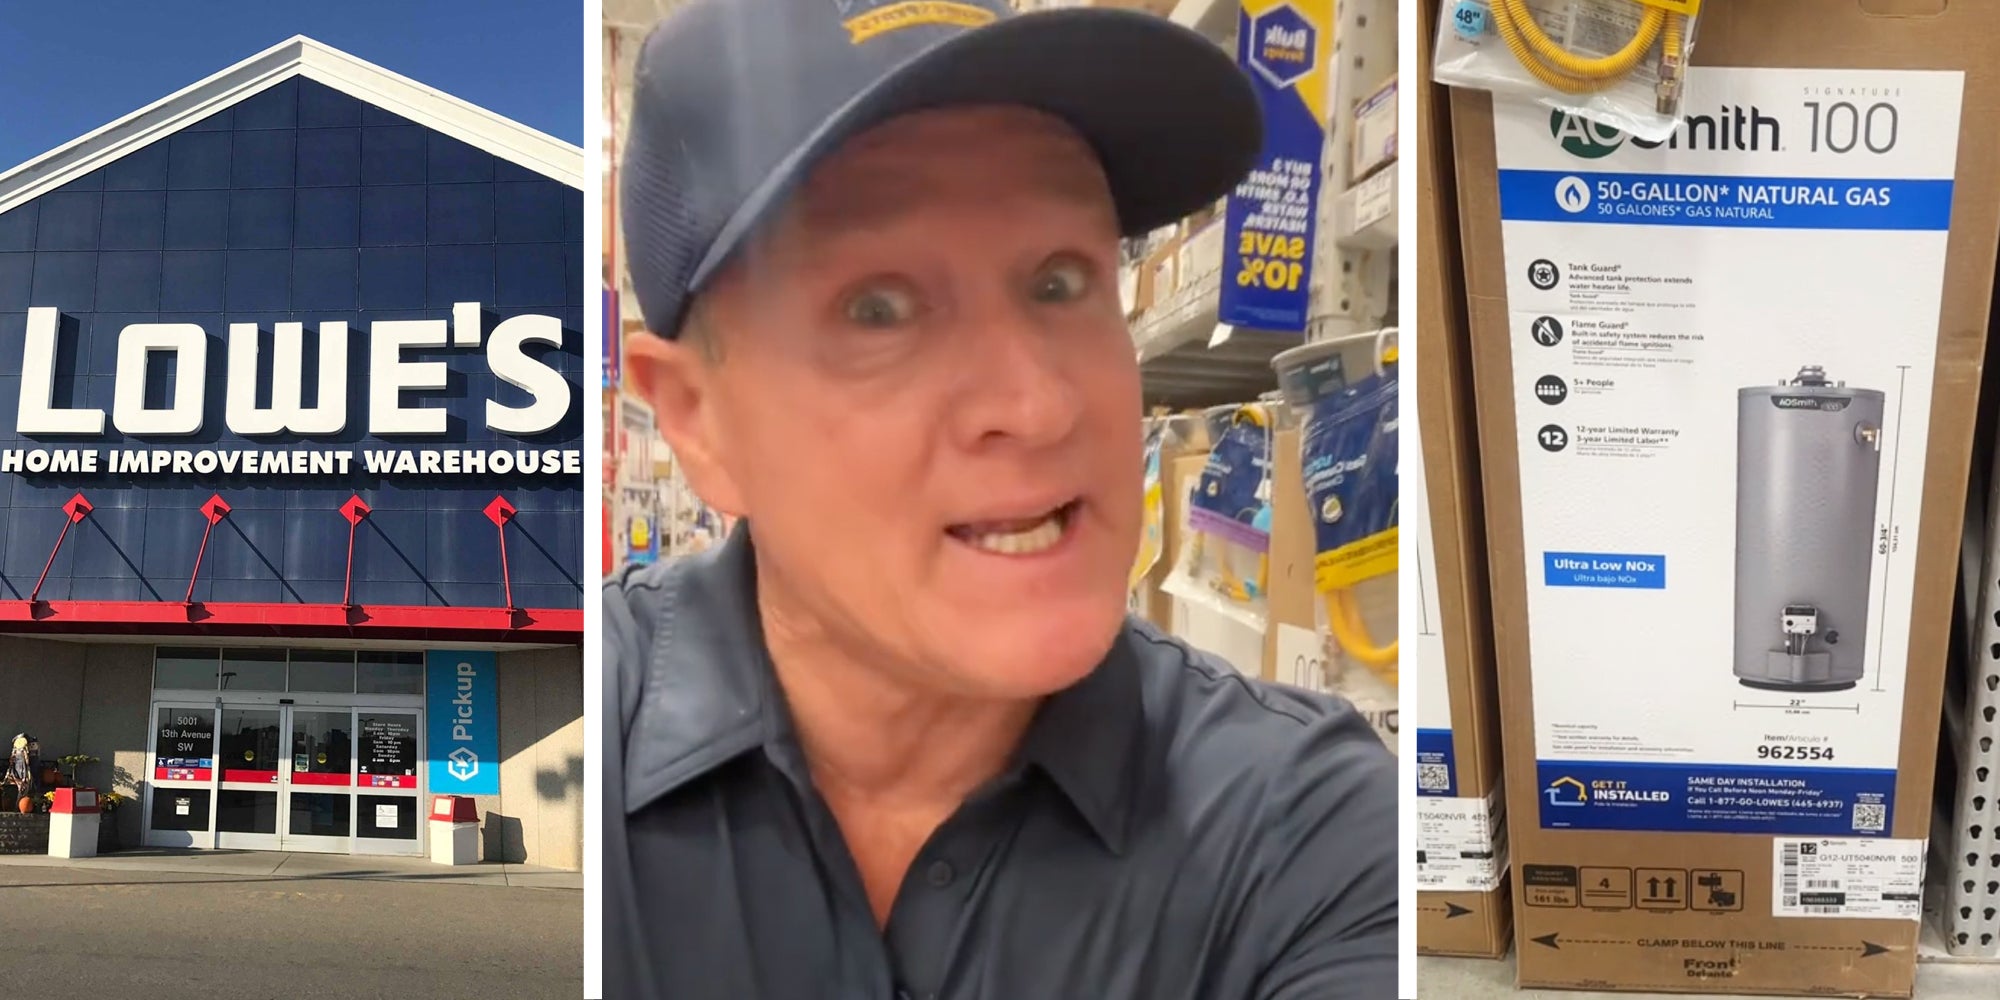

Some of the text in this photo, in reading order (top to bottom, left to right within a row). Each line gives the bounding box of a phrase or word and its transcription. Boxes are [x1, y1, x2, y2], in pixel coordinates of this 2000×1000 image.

[1456, 8, 1480, 24] 48"
[1803, 86, 1902, 97] SIGNATURE
[1804, 100, 1899, 154] 100
[1738, 186, 1839, 207] NATURAL
[1846, 187, 1891, 207] GAS
[1597, 203, 1613, 216] 50
[1685, 206, 1712, 219] GAS
[1715, 206, 1775, 220] NATURAL
[1568, 263, 1588, 272] Tank
[1568, 274, 1604, 282] Advanced
[1624, 276, 1662, 285] protection
[1569, 283, 1590, 291] water
[1592, 283, 1615, 291] heater
[1572, 320, 1596, 329] Flame
[1599, 331, 1621, 340] safety
[1623, 333, 1647, 341] system
[16, 302, 571, 436] LOWE'S
[1574, 379, 1615, 388] 5+ People
[1576, 425, 1680, 437] 12-year Limited Warranty
[1540, 431, 1564, 446] 12
[1576, 435, 1601, 445] 3-year
[1604, 436, 1634, 444] Limited
[2, 450, 581, 475] HOME IMPROVEMENT WAREHOUSE
[1554, 558, 1656, 572] Ultra Low NOx
[1573, 574, 1637, 585] Ultra bajo NOx
[452, 662, 477, 741] Pickup
[177, 716, 198, 726] 5001
[161, 730, 212, 740] 13th Avenue
[177, 742, 194, 752] SW
[1757, 745, 1835, 760] 962554
[1591, 780, 1628, 790] GET IT
[1687, 777, 1806, 788] SAME DAY INSTALLATION
[1593, 789, 1670, 802] INSTALLED
[1687, 796, 1843, 809] Call 1-877-GO-LOWES (465-6937)
[1801, 843, 1817, 854] 12
[1819, 854, 1919, 863] G12-UT5040NVR 500
[1599, 877, 1610, 889] 4
[1637, 938, 1786, 950] CLAMP BELOW THIS LINE
[1683, 958, 1736, 969] Front
